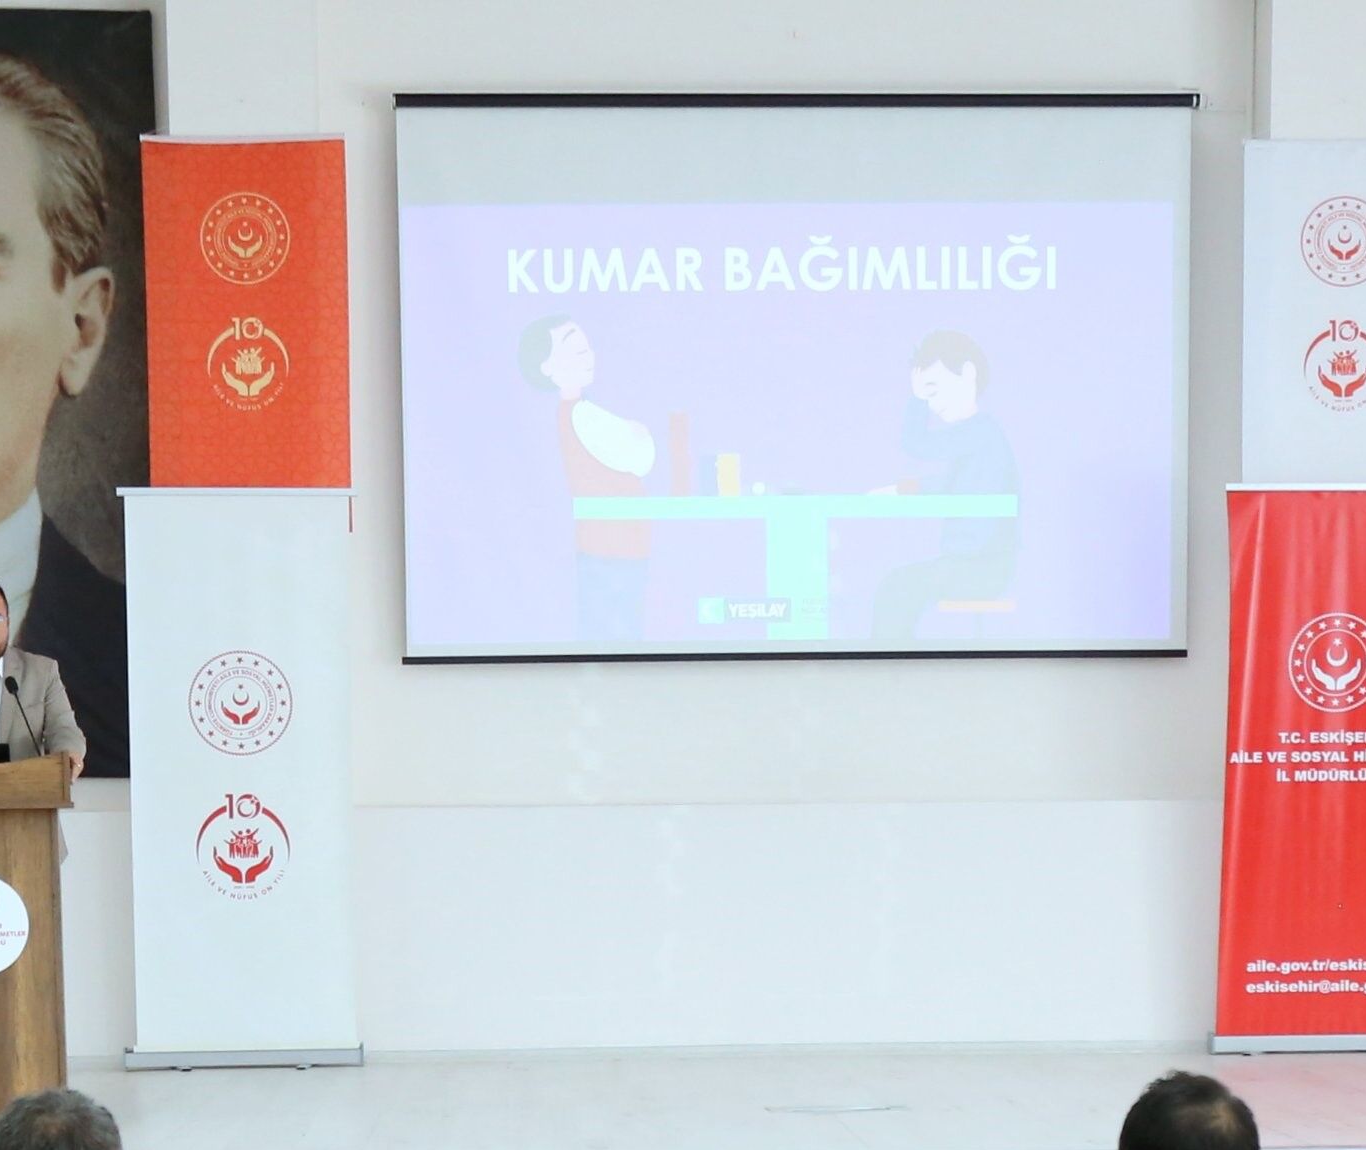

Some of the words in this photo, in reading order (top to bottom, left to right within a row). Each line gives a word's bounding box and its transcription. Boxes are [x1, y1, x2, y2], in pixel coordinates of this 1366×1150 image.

[507, 247, 704, 294] KUMAR
[723, 234, 1058, 293] BAĞIMLILIĞI
[230, 316, 264, 341] 10
[1329, 319, 1359, 342] 10
[1278, 732, 1306, 744] T.C.
[1230, 750, 1263, 764] AİLE
[1267, 752, 1287, 763] VE
[1291, 751, 1349, 763] SOSYAL
[1276, 768, 1291, 782] İL
[224, 793, 261, 820] 10
